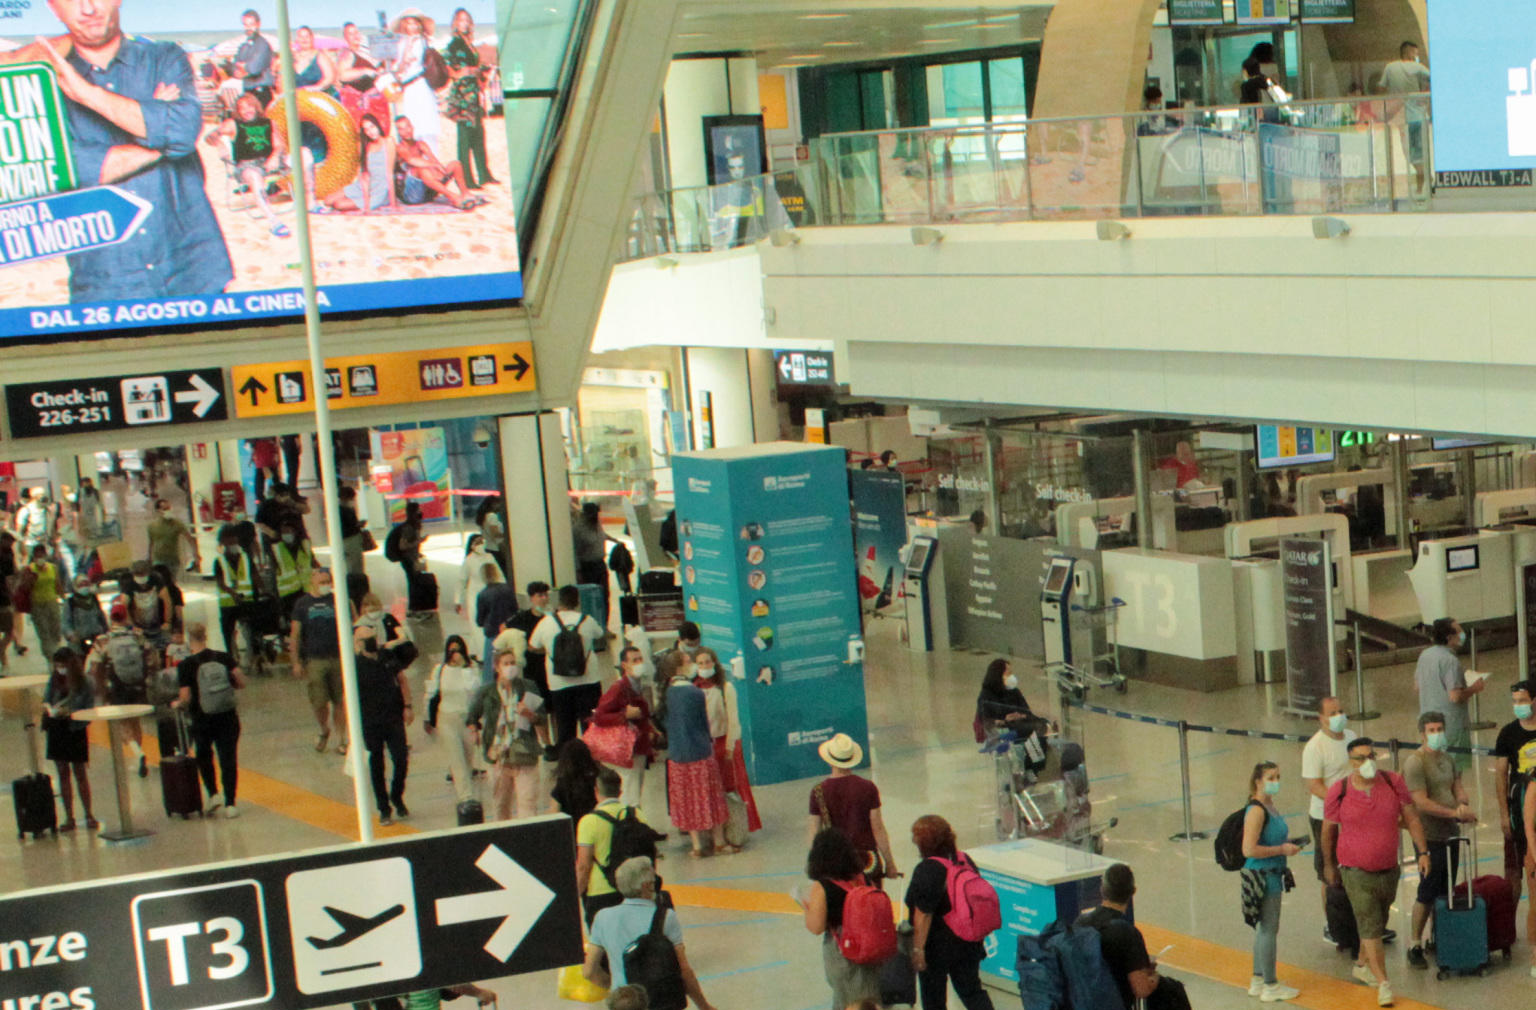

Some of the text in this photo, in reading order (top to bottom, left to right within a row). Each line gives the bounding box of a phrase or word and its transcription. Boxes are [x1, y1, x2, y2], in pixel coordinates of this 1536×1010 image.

[0, 74, 47, 119] UN
[20, 116, 55, 161] IN
[1437, 171, 1496, 186] LEDWALL
[38, 202, 53, 222] A
[3, 209, 116, 260] DI MORTO
[30, 310, 80, 329] DAL
[82, 307, 112, 326] 26
[115, 299, 208, 322] AGOSTO
[211, 297, 241, 315] AL
[30, 387, 109, 409] Check-in
[39, 407, 112, 427] 226-251
[938, 473, 990, 492] Self check-in
[1036, 483, 1093, 503] Self check-in
[1124, 570, 1177, 639] T3
[0, 930, 89, 972] nze
[147, 915, 250, 987] T3
